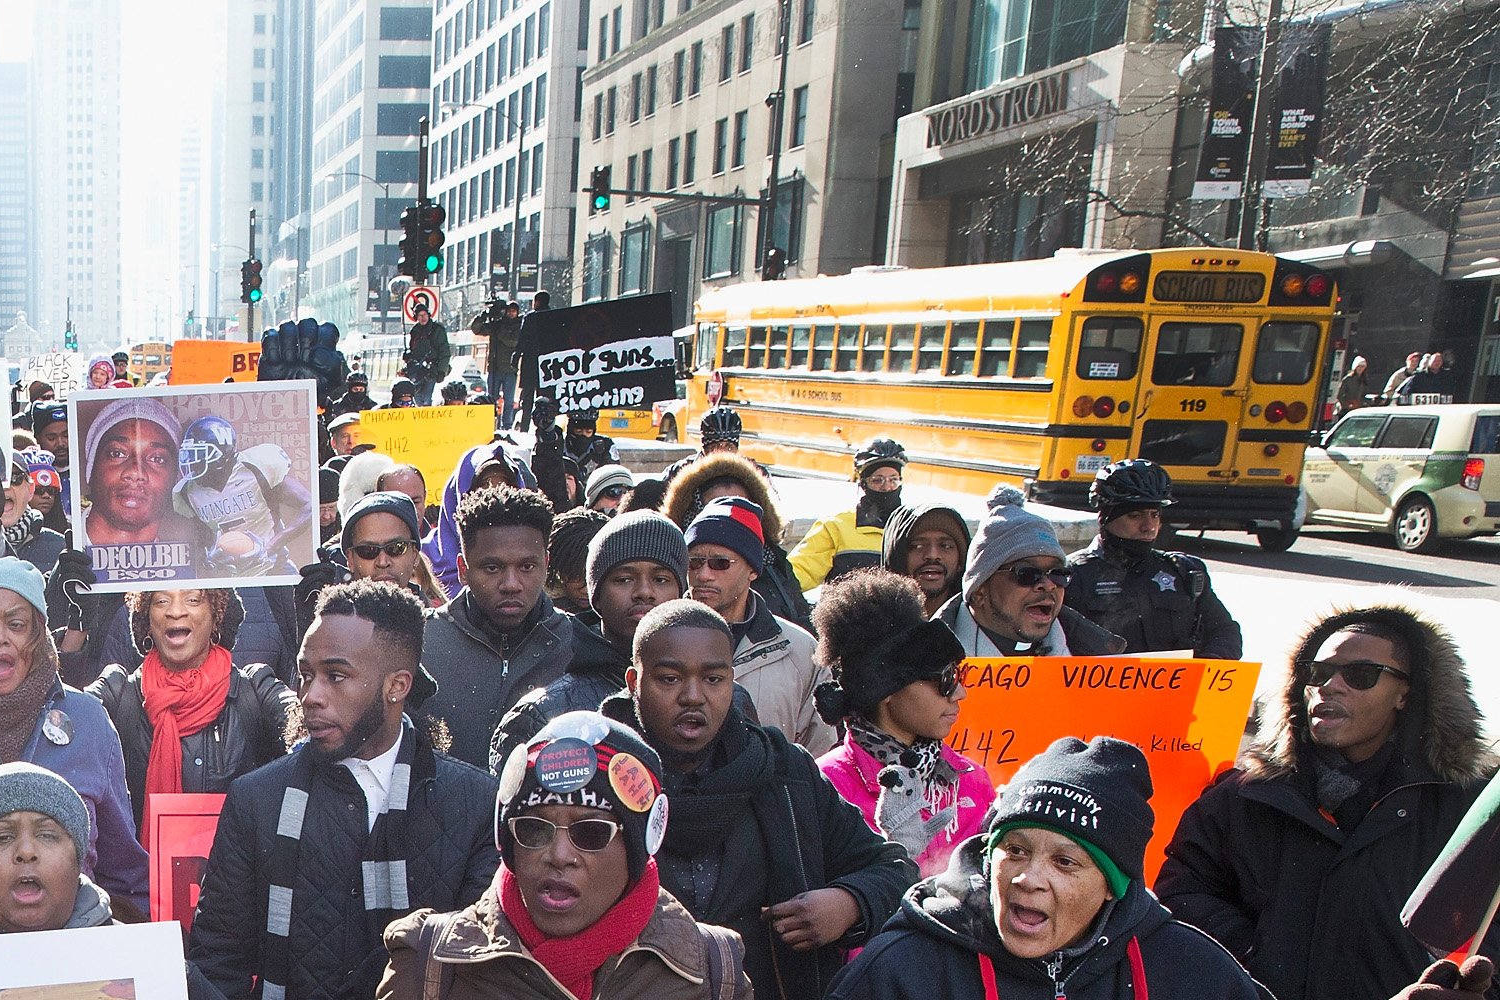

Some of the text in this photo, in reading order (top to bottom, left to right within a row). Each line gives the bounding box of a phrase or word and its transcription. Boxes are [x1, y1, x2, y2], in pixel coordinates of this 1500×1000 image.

[924, 71, 1070, 149] NORDSTROM
[1213, 119, 1239, 127] TOWN
[1299, 114, 1315, 122] YOU
[1211, 126, 1242, 135] RISING
[1156, 274, 1260, 299] SCHOOL BUS
[29, 353, 72, 369] BLACK
[24, 367, 70, 380] LIVES
[16, 380, 78, 399] MTER
[808, 391, 842, 401] SCHOOL BUS
[1179, 399, 1207, 412] 119
[1415, 395, 1438, 404] 6310
[364, 410, 453, 424] CHICAGO VIOLENCE
[210, 425, 233, 446] W
[385, 438, 409, 454] 442
[198, 491, 256, 522] WINGATE
[91, 543, 191, 571] DECOLBIE
[108, 569, 177, 581] ESCO
[1062, 665, 1187, 690] VIOLENCE
[541, 747, 590, 760] PROTECT
[541, 758, 590, 772] CHILDREN
[541, 767, 590, 782] NOT GUNS
